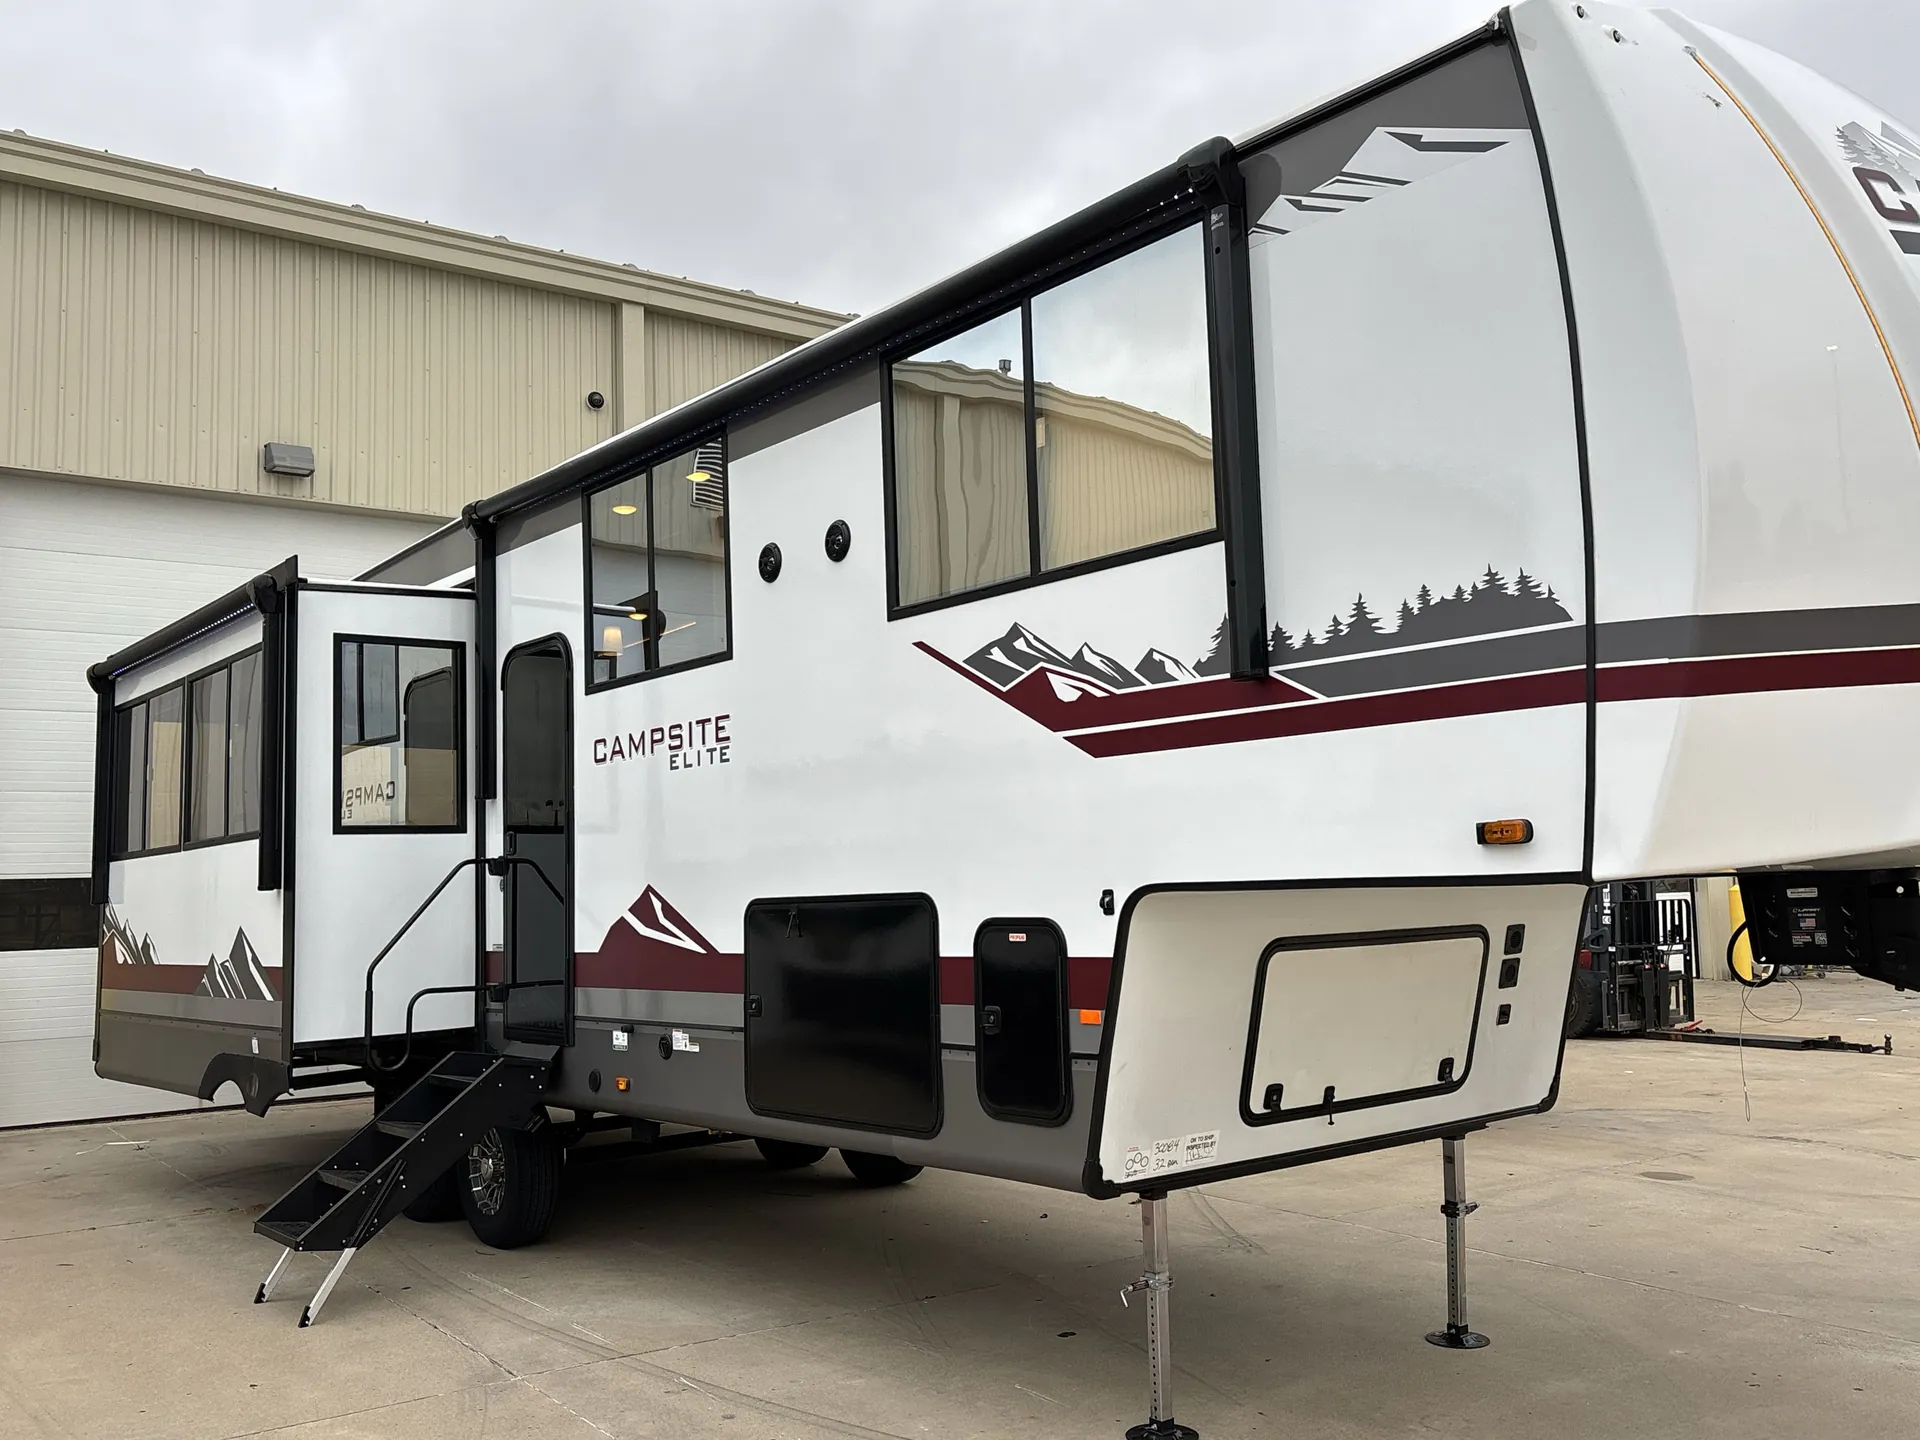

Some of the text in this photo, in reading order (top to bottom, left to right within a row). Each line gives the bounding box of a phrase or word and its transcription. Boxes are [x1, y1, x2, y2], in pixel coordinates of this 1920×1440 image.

[593, 714, 731, 764] CAMPSITE
[669, 745, 730, 771] ELITE
[1185, 1142, 1209, 1151] INSPECTED
[1190, 1136, 1197, 1144] OK
